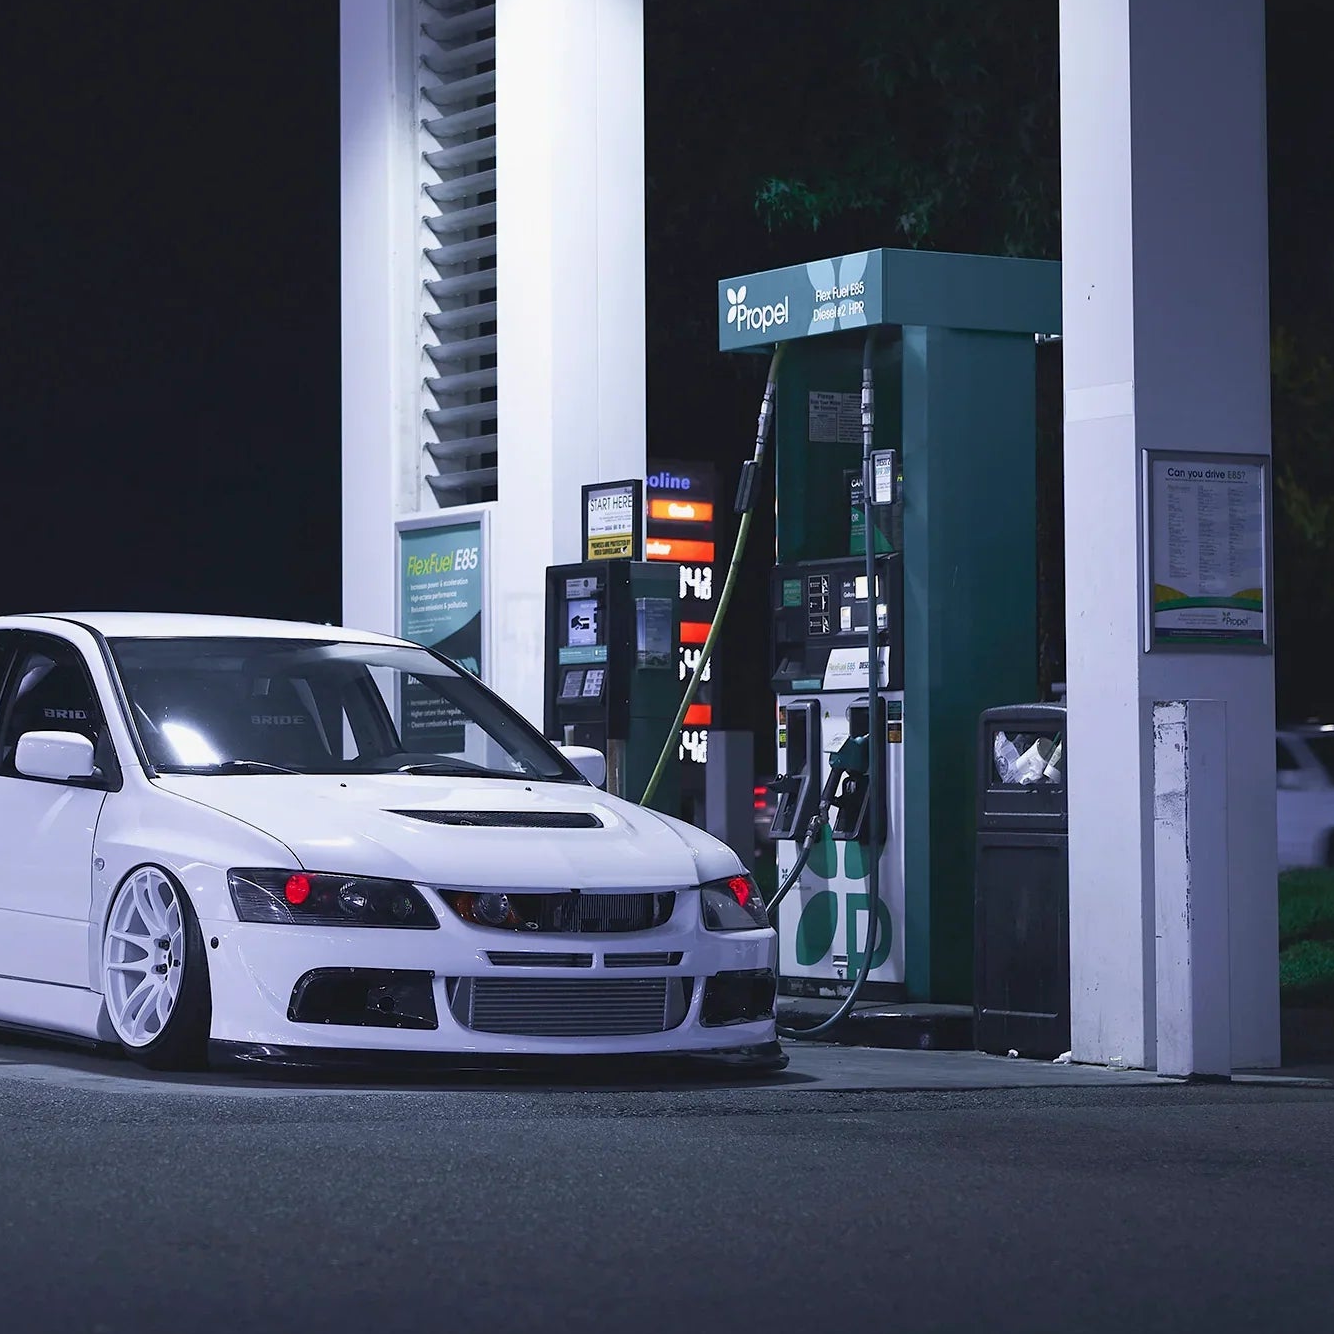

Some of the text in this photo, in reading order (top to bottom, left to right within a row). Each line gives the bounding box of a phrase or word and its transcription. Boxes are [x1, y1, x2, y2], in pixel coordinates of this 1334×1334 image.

[815, 281, 865, 302] Flex Fuel E85
[737, 295, 789, 333] Propel
[813, 300, 865, 322] Diesel #2 HPR
[646, 471, 691, 489] oline
[1167, 468, 1246, 480] Can you drive E85?
[590, 494, 632, 512] START HERE
[408, 547, 478, 576] FlexFuel E85
[43, 708, 87, 719] BRID
[251, 715, 306, 725] BRIDE
